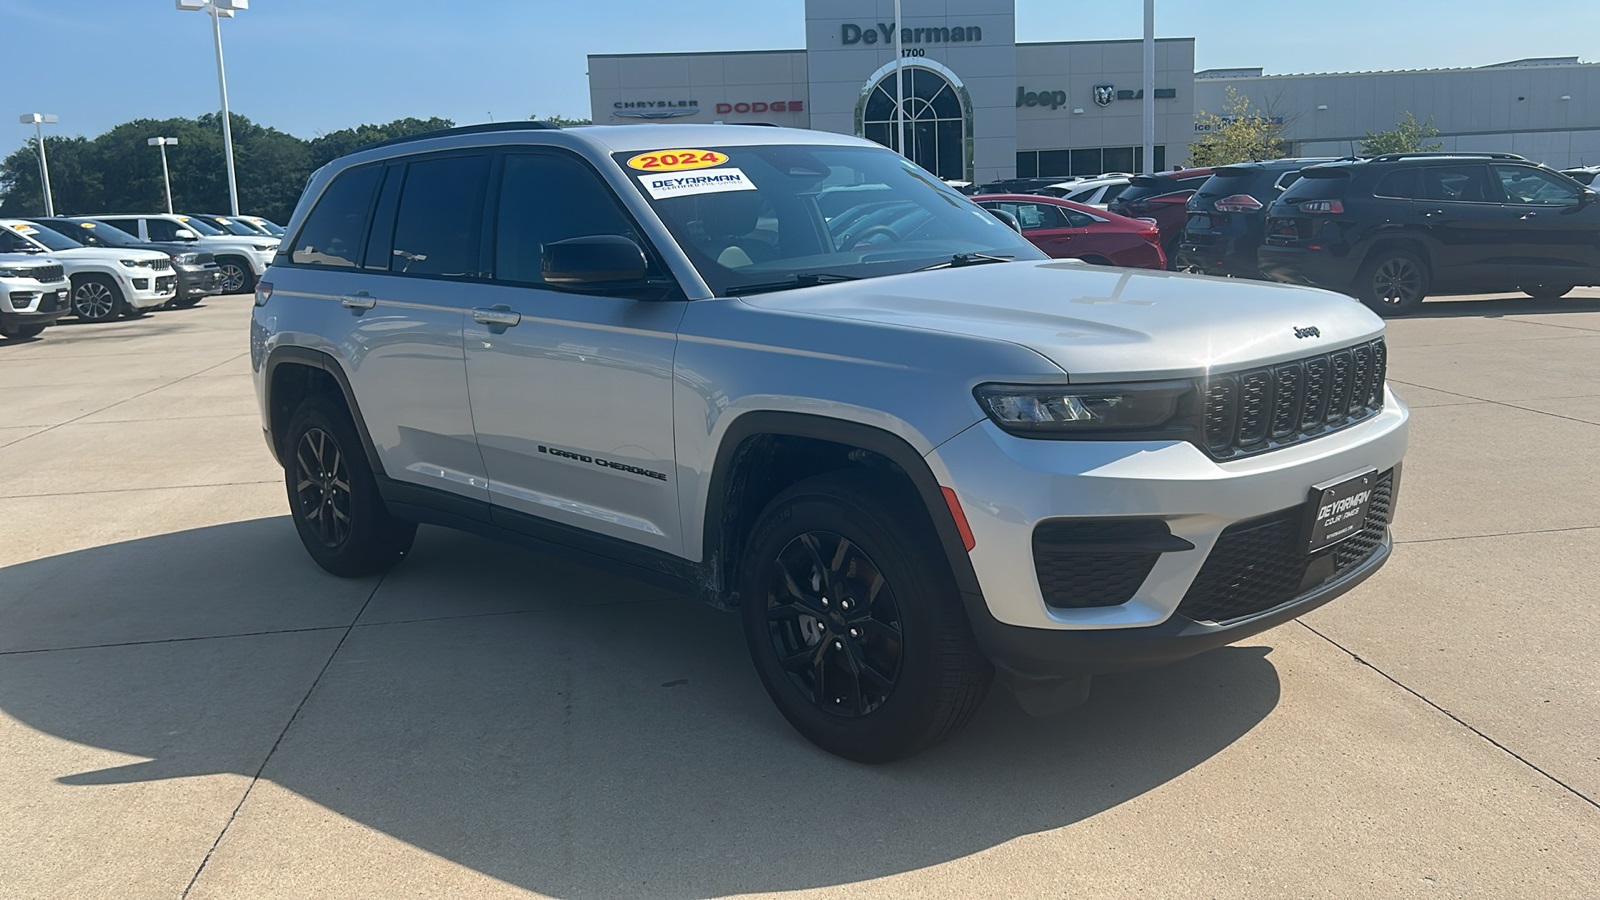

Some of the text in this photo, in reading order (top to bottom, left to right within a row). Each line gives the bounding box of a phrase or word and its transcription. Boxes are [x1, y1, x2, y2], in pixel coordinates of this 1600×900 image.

[841, 22, 982, 45] DeYarman
[901, 48, 925, 58] 1700
[613, 100, 699, 109] CHRYSLER
[1016, 86, 1066, 110] Jeep
[716, 101, 803, 114] DODGE
[640, 152, 718, 168] 2024
[652, 174, 741, 188] DEYARMAN
[662, 183, 700, 191] CERTIFIED
[1293, 325, 1320, 339] Jeep
[549, 447, 667, 481] GRAND CHEROKEE
[1317, 489, 1371, 521] DEYARMAN
